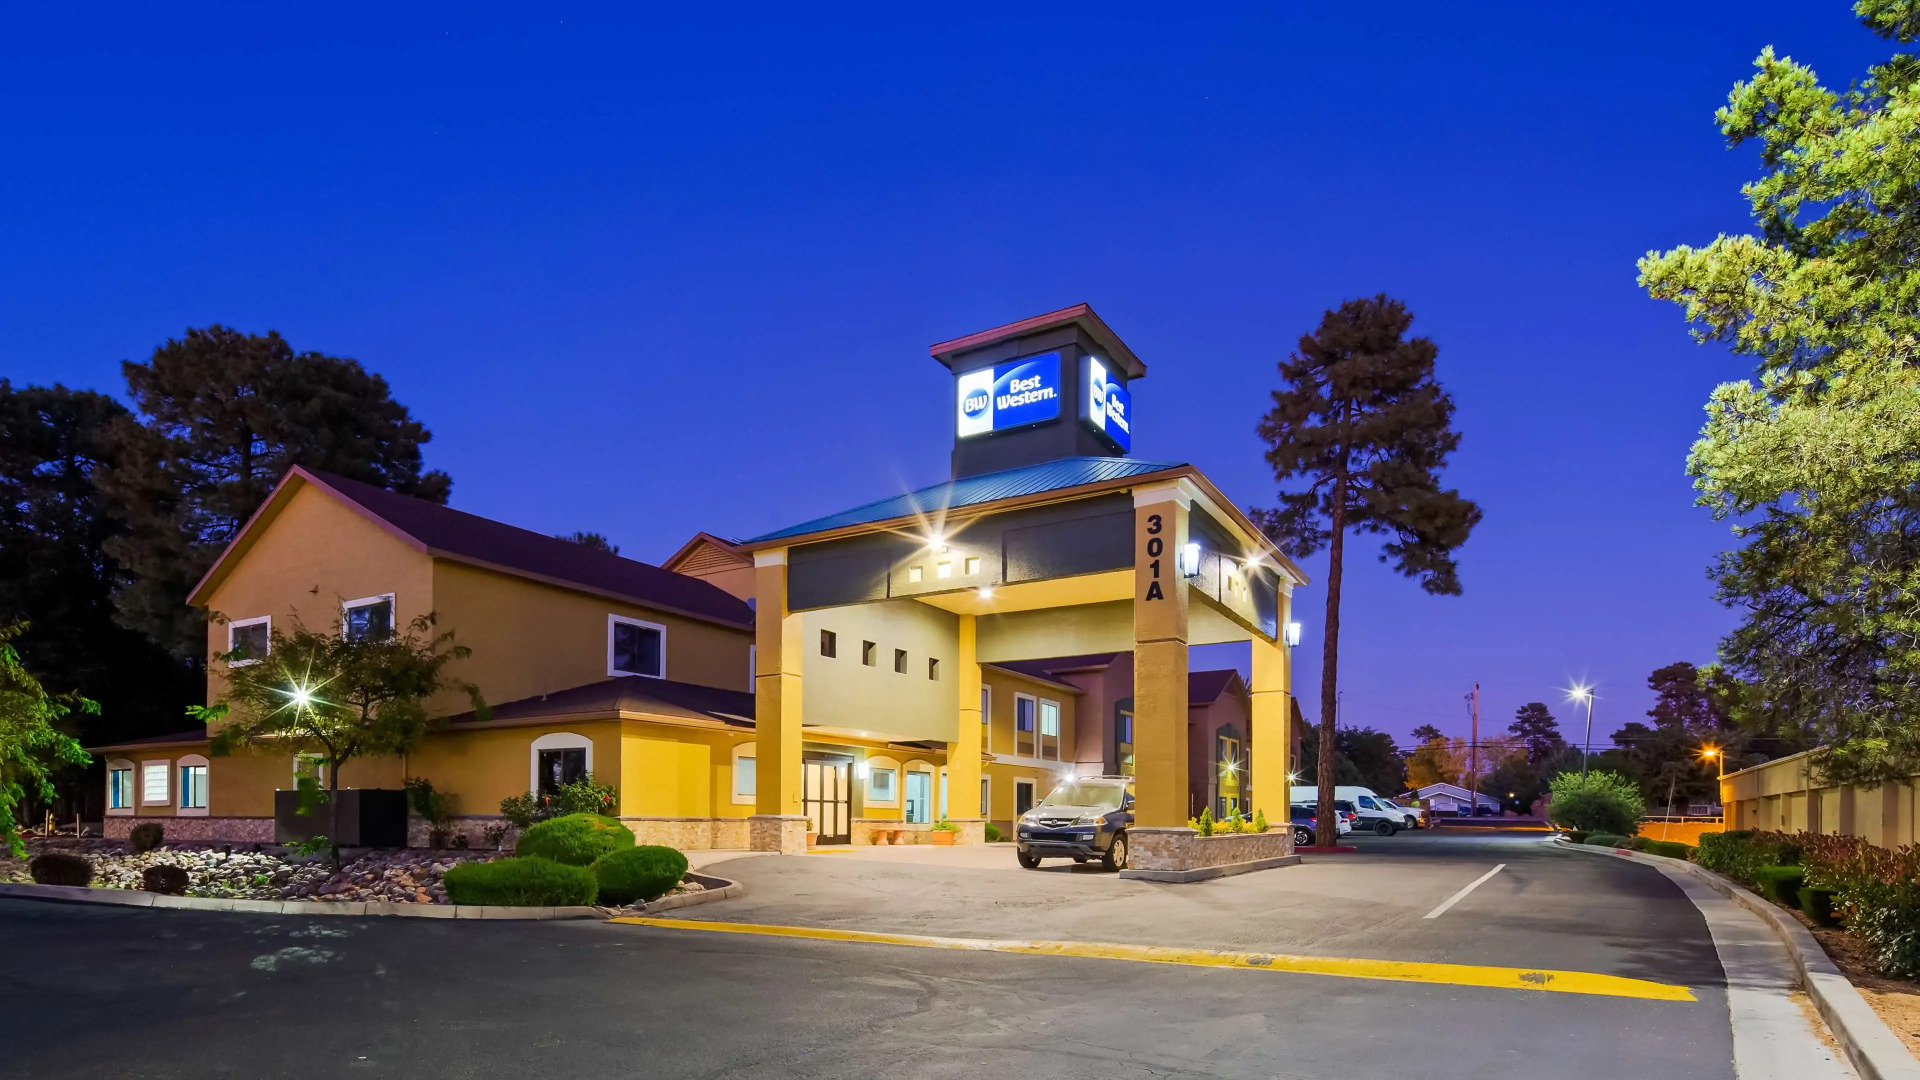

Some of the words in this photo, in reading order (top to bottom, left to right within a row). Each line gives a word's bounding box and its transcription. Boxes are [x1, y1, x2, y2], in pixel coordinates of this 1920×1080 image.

[1010, 375, 1041, 394] Best
[964, 394, 988, 413] BW
[1111, 393, 1125, 416] Best
[1145, 514, 1164, 601] 301A
